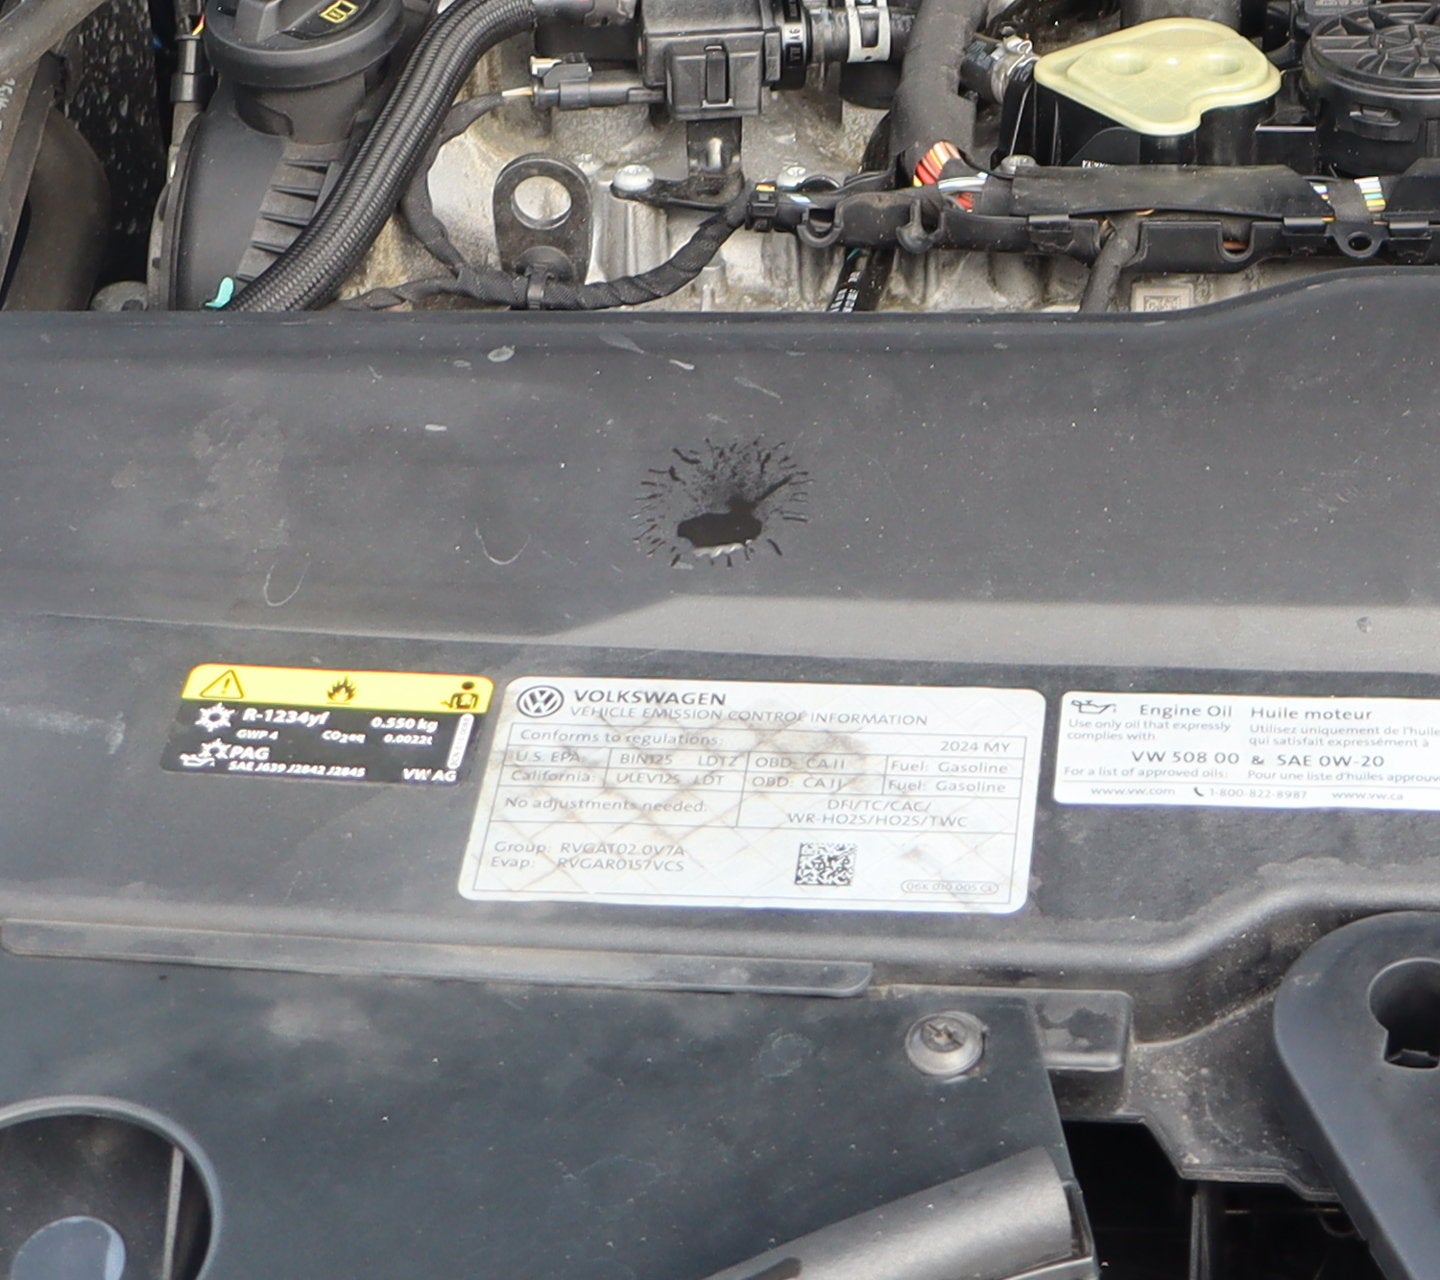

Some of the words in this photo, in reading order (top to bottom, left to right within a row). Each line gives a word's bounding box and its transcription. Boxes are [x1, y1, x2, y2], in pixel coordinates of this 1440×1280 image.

[574, 689, 726, 705] VOLKSWAGEN
[571, 706, 636, 718] VEHICLE
[643, 708, 723, 720] EMISSION
[728, 710, 807, 723] CONTROL
[811, 713, 928, 726] INFORMATION
[1140, 704, 1201, 719] Engine
[1208, 705, 1232, 717] Oil
[1250, 707, 1299, 719] Huile
[1304, 708, 1373, 720] moteur
[242, 708, 330, 726] R-1234yf
[371, 716, 416, 730] 0.550
[417, 719, 438, 733] kg
[1068, 719, 1092, 728] Use
[1095, 719, 1121, 731] only
[1125, 720, 1140, 729] oil
[1143, 720, 1169, 729] that
[1172, 720, 1231, 732] expressly
[521, 729, 599, 742] Conforms
[605, 731, 620, 742] to
[1067, 732, 1123, 742] complies
[1127, 731, 1155, 740] with
[1250, 724, 1297, 734] Utilisez
[1301, 725, 1379, 736] uniquement
[1384, 726, 1399, 735] de
[940, 741, 979, 752] 2024
[984, 742, 1011, 753] MY
[1249, 736, 1269, 747] qui
[1273, 736, 1324, 746] satisfait
[230, 746, 270, 760] PAG
[1131, 751, 1165, 762] VW
[1173, 751, 1207, 763] 508
[1214, 752, 1240, 764] 00
[1251, 755, 1264, 765] &
[1277, 754, 1312, 767] SAE
[1319, 755, 1385, 768] 0W-20
[229, 761, 254, 772] SAE
[891, 760, 927, 772] Fuel:
[938, 761, 1008, 774] Gasoline
[1064, 767, 1084, 776] For
[1099, 767, 1117, 776] list
[1121, 767, 1135, 776] of
[1138, 768, 1198, 779] approved
[403, 768, 430, 781] VW
[430, 769, 457, 782] AG
[1248, 770, 1276, 780] Pour
[1280, 772, 1303, 781] une
[1307, 771, 1332, 781] liste
[889, 779, 926, 791] Fuel:
[936, 780, 1006, 793] Gasoline
[1091, 787, 1175, 796] www.vw.com
[505, 797, 528, 808] No
[533, 797, 637, 811] adjustments
[494, 842, 550, 854] Group:
[491, 857, 534, 869] Evap:
